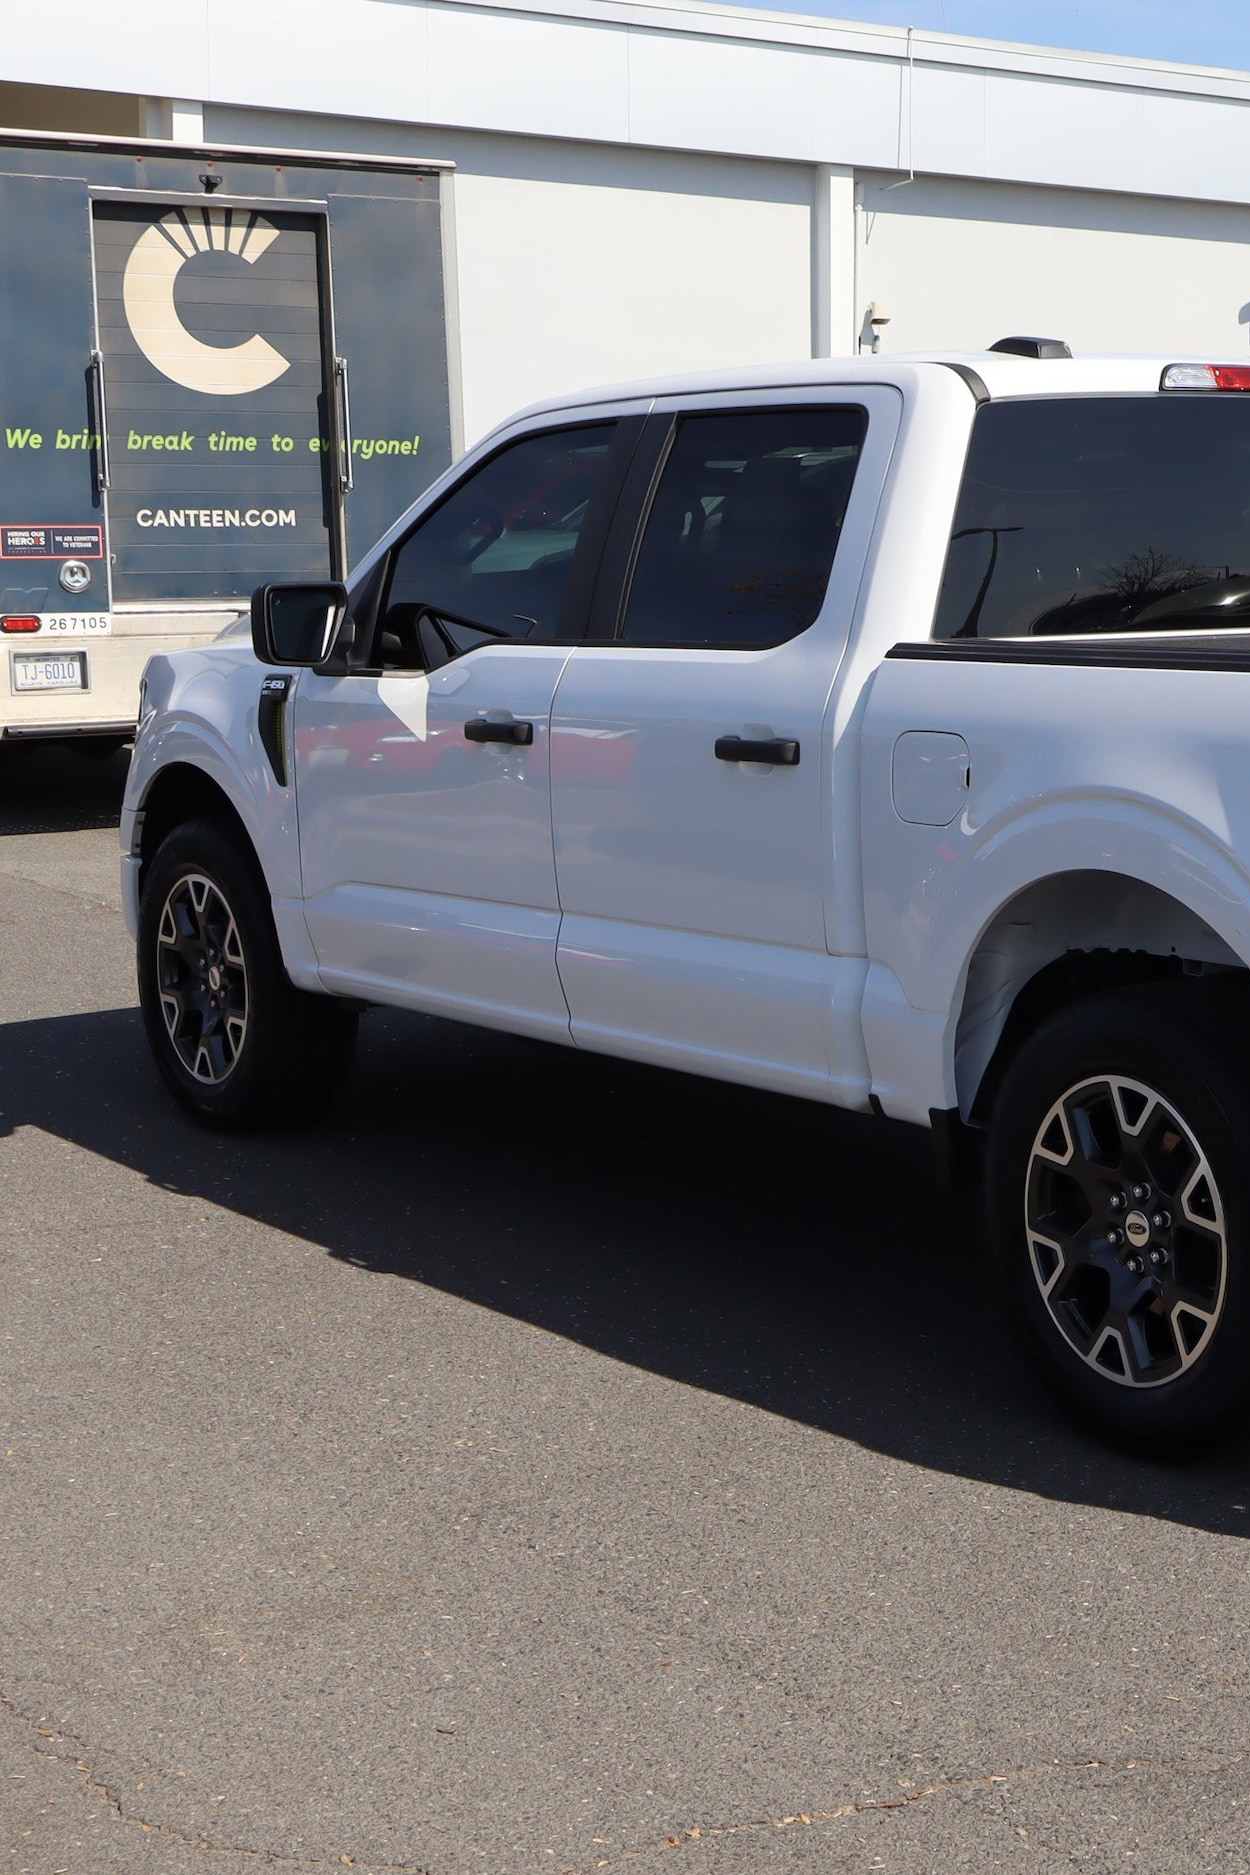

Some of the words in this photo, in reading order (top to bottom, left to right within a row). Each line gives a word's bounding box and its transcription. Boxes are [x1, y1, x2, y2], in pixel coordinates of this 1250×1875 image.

[5, 428, 43, 449] We
[55, 429, 109, 451] brin
[127, 430, 195, 451] break
[208, 431, 257, 452] time
[271, 434, 294, 453] to
[136, 509, 297, 527] CANTEEN.COM
[8, 537, 46, 545] HEROES
[49, 617, 107, 630] 267105
[22, 662, 75, 681] TJ-6010
